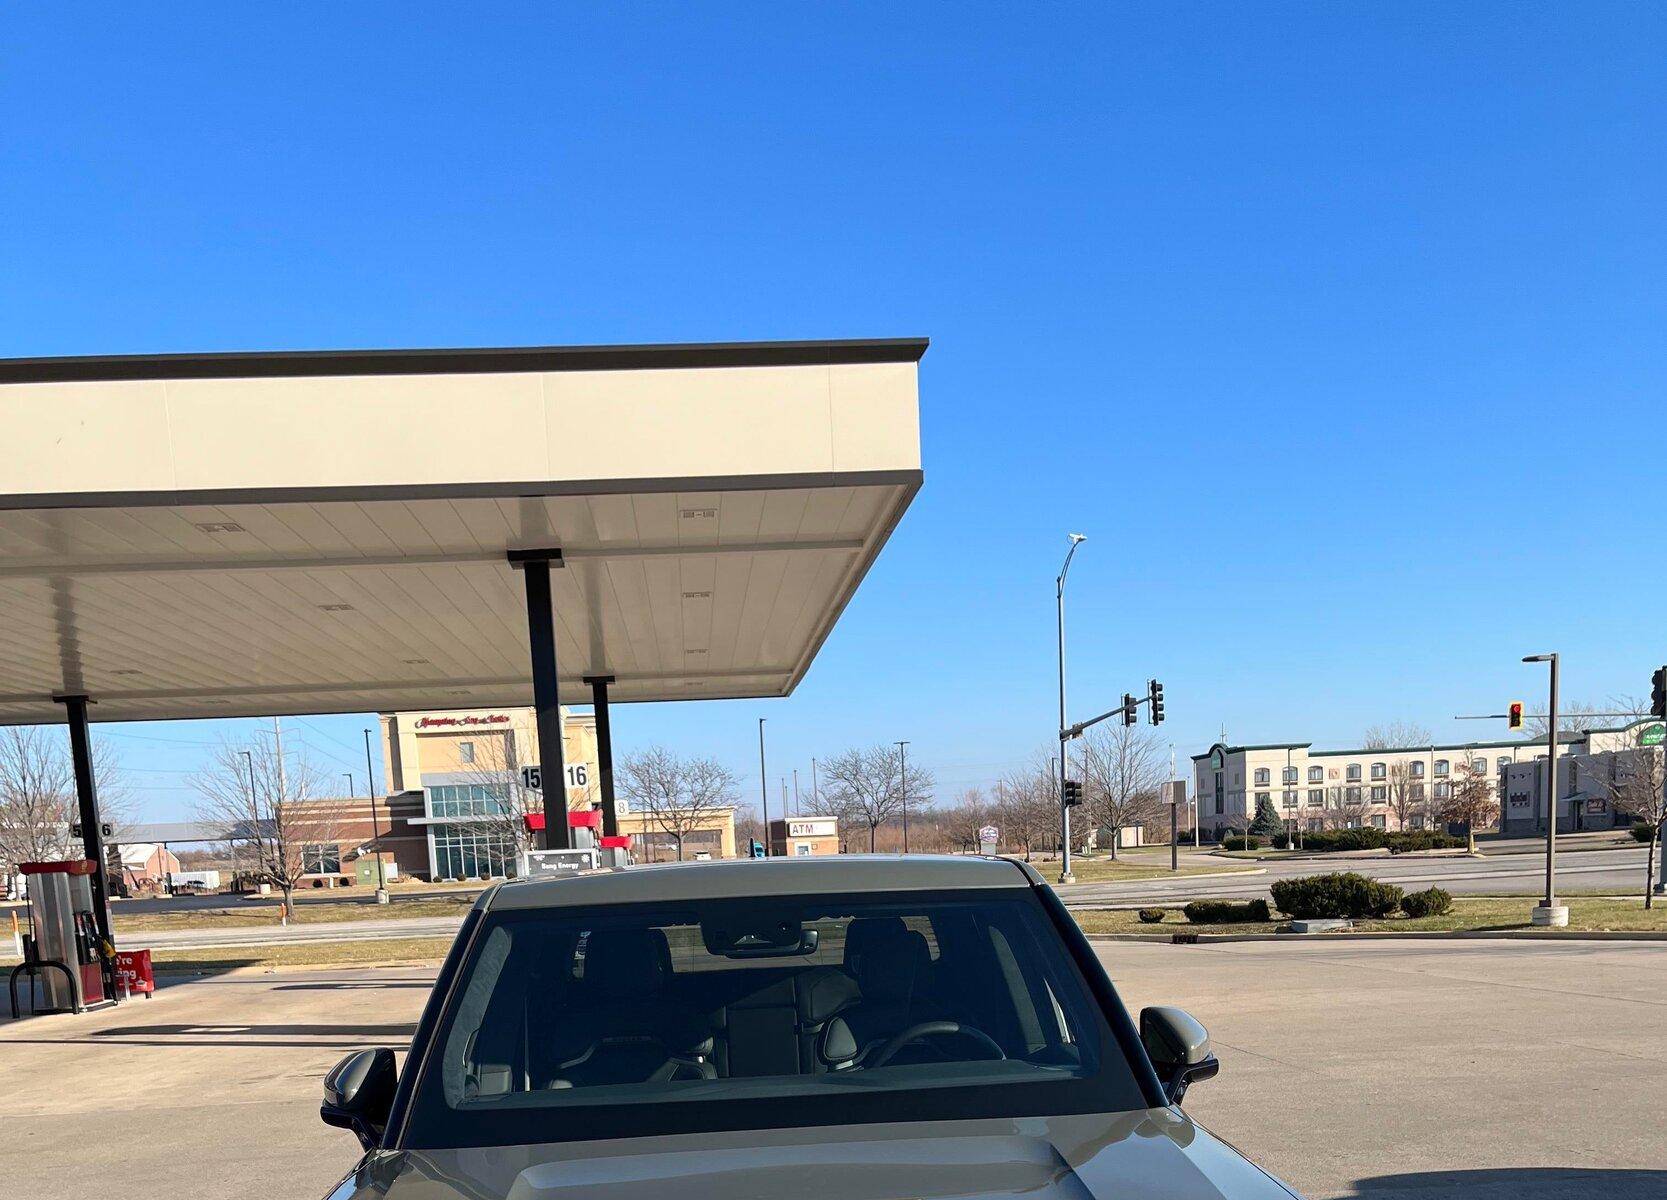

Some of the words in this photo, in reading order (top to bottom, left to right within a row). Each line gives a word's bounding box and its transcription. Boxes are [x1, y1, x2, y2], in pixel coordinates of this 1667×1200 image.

[522, 768, 541, 788] 15
[567, 766, 587, 786] 16
[618, 802, 626, 813] 8
[73, 825, 82, 837] 5
[101, 824, 111, 836] 6
[792, 824, 814, 834] ATM
